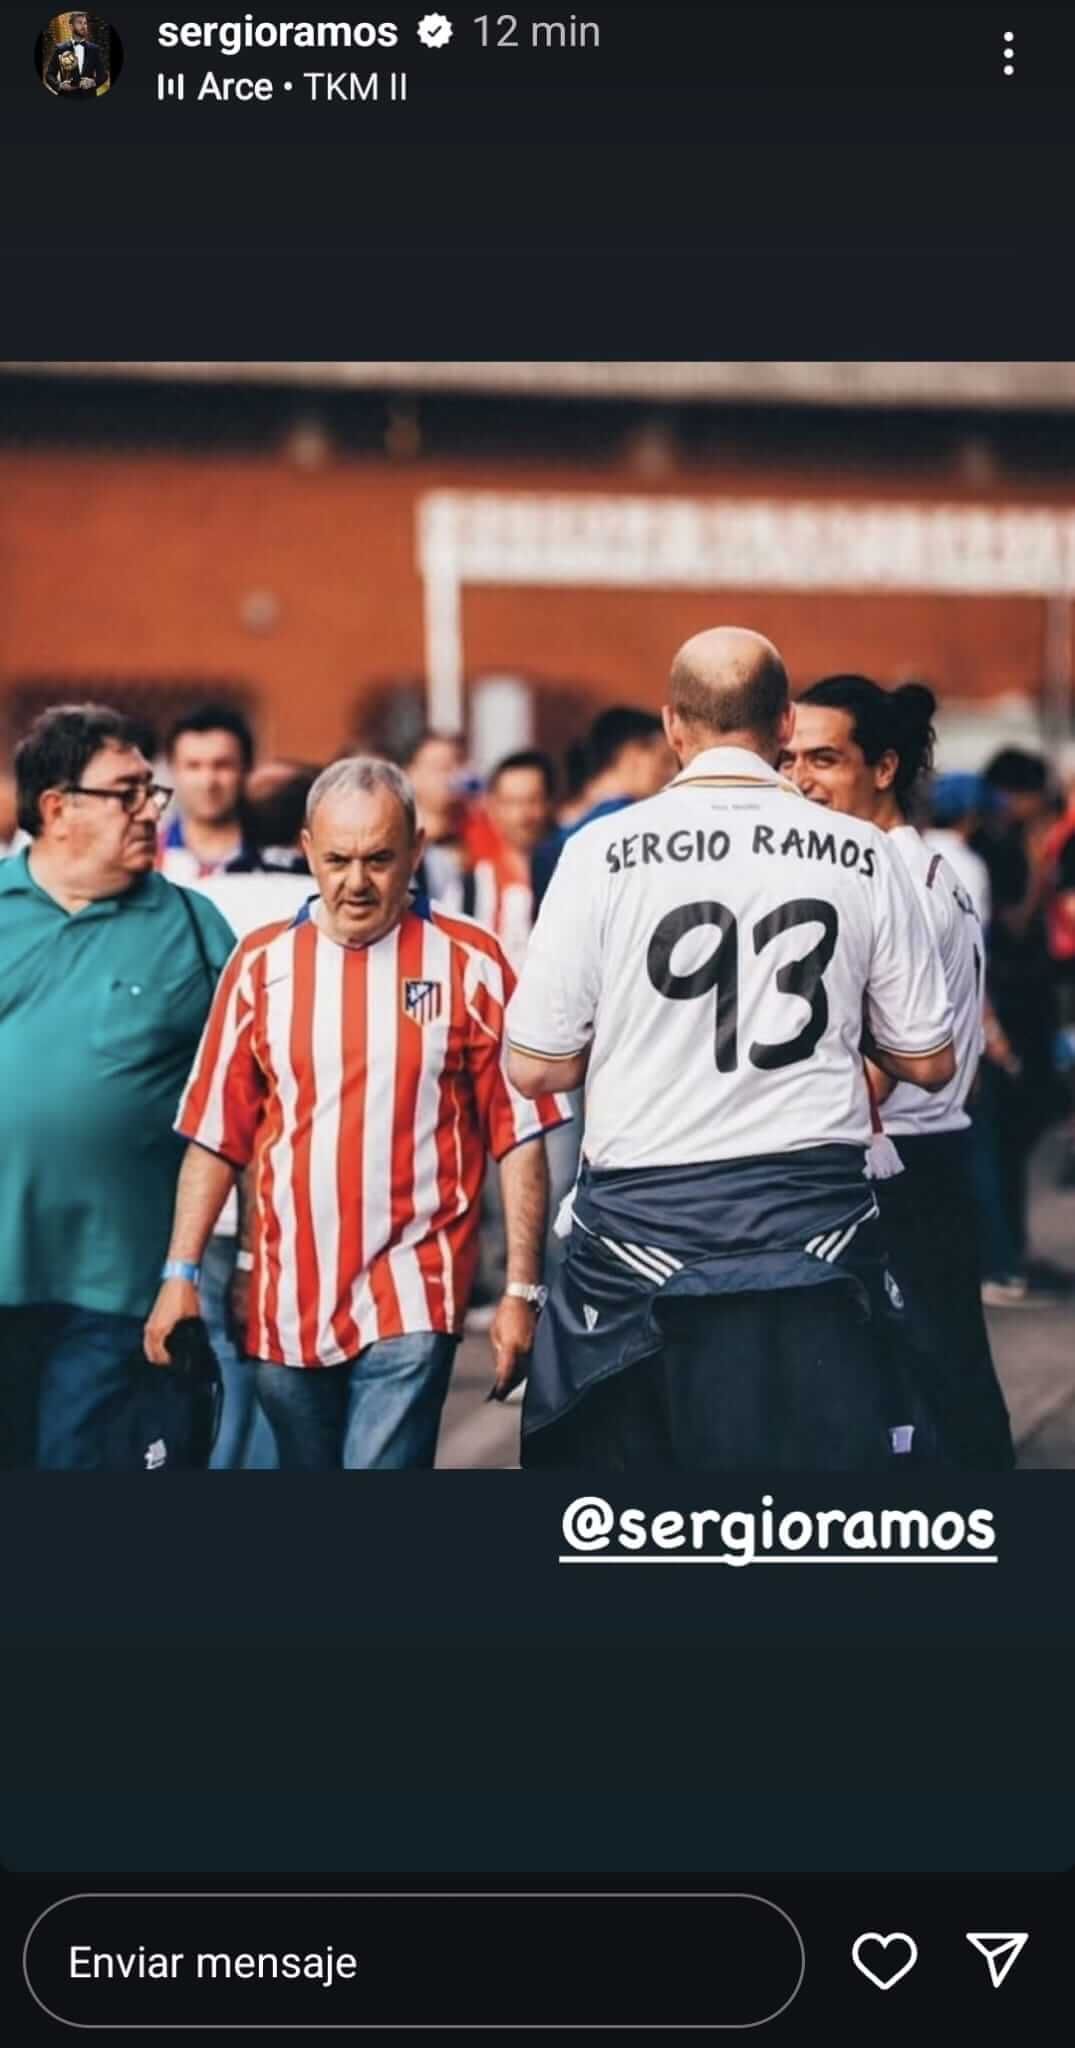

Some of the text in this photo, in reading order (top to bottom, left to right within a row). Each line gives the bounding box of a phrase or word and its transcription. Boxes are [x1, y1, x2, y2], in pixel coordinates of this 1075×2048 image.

[605, 824, 876, 878] SERGIO RAMOS
[646, 898, 839, 1073] 93
